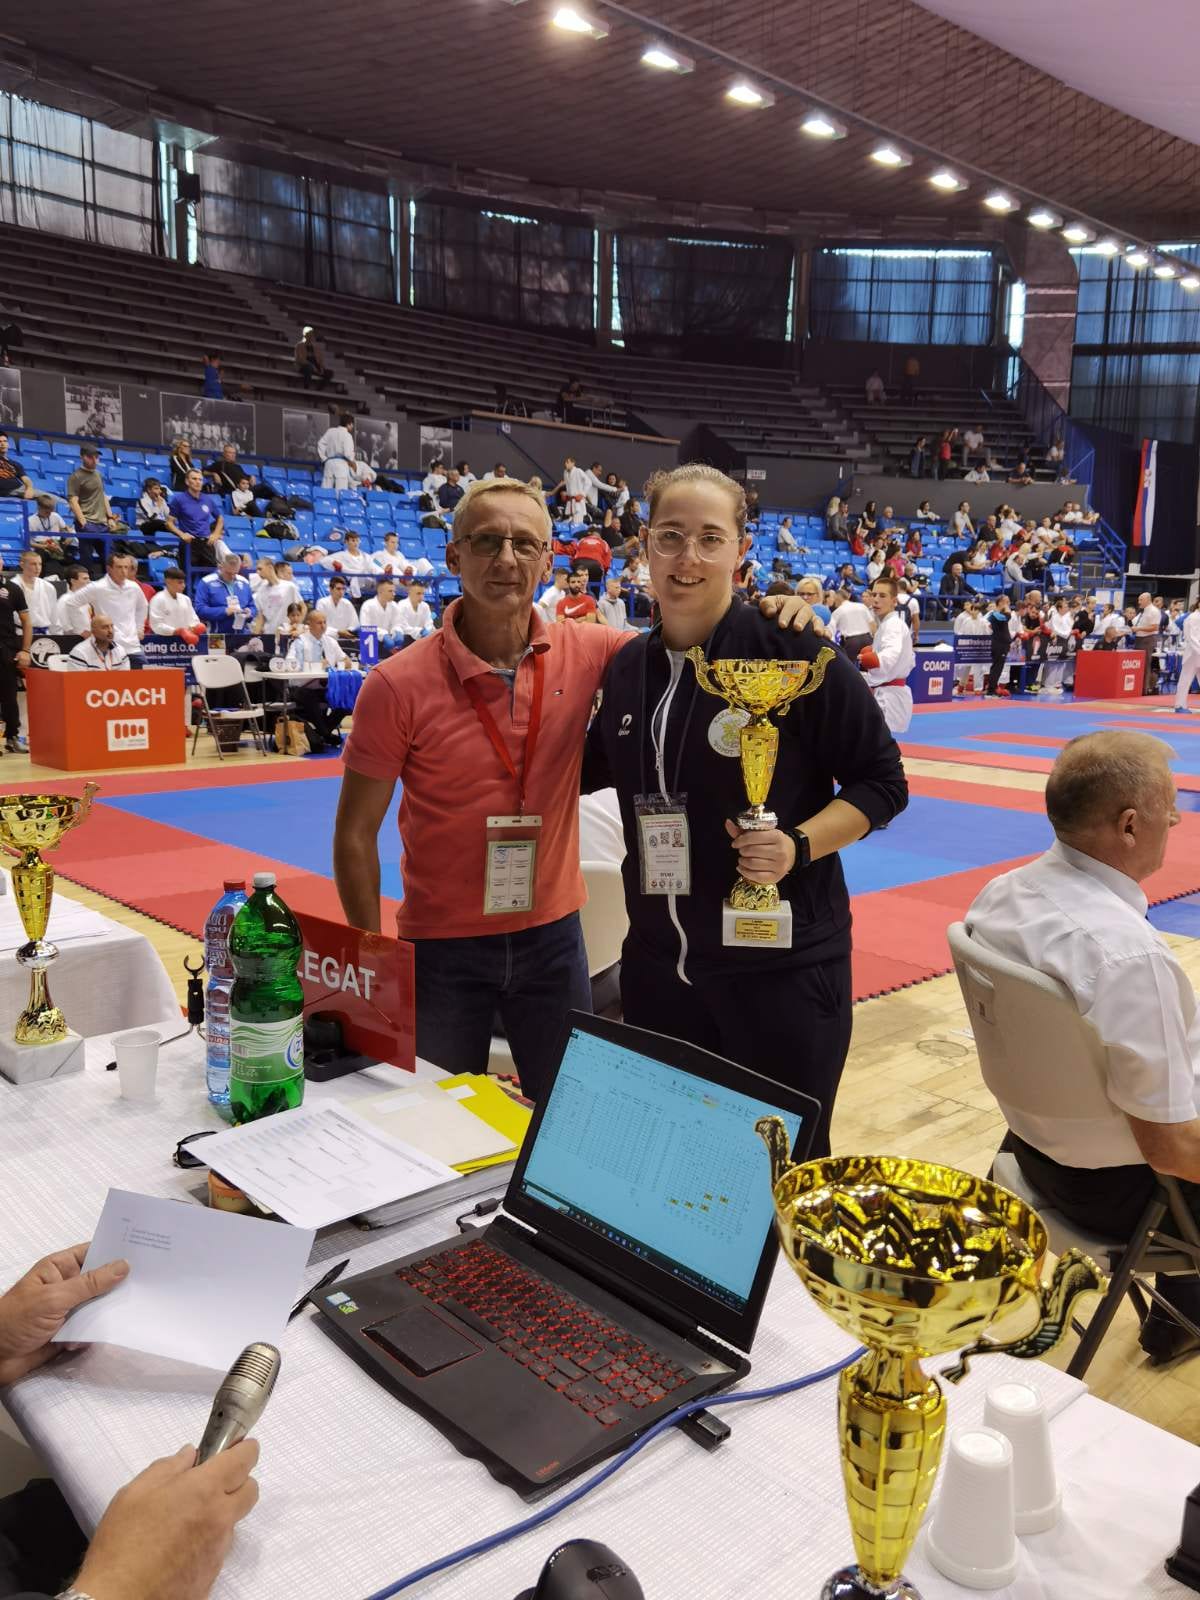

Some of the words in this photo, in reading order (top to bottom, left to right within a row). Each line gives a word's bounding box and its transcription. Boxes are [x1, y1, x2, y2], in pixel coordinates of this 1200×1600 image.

[141, 642, 168, 653] ding
[364, 634, 374, 658] 1
[922, 660, 951, 672] COACH
[1122, 659, 1141, 670] COACH
[86, 687, 167, 708] COACH
